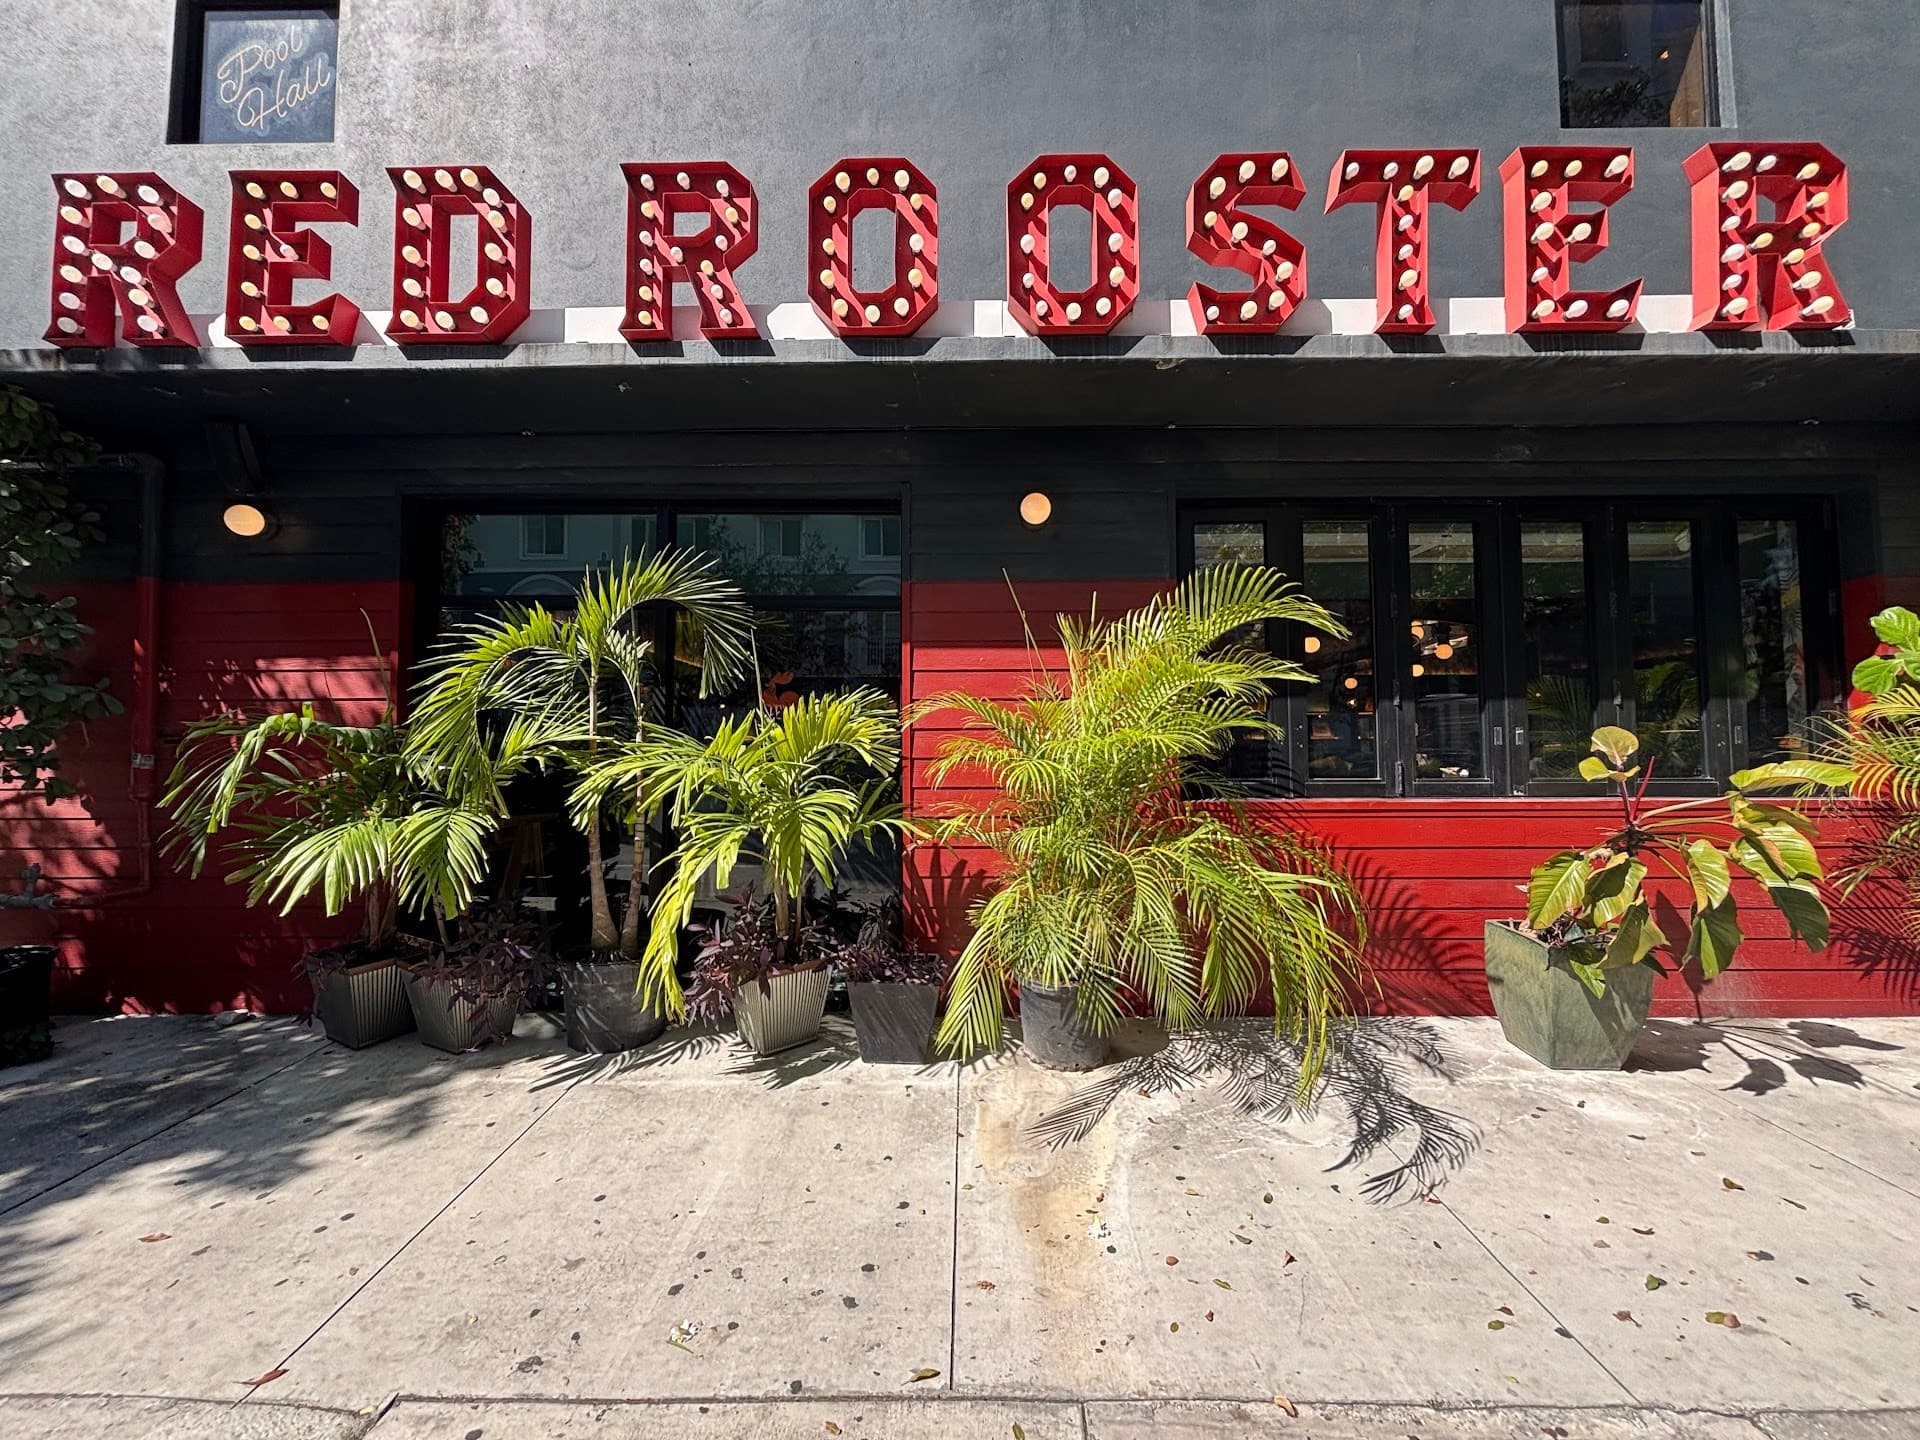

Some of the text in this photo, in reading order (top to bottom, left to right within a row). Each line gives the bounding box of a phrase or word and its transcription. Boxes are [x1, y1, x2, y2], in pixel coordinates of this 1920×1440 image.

[217, 24, 303, 104] Pool
[237, 57, 331, 130] Hall
[43, 142, 1851, 347] RED ROOSTER
